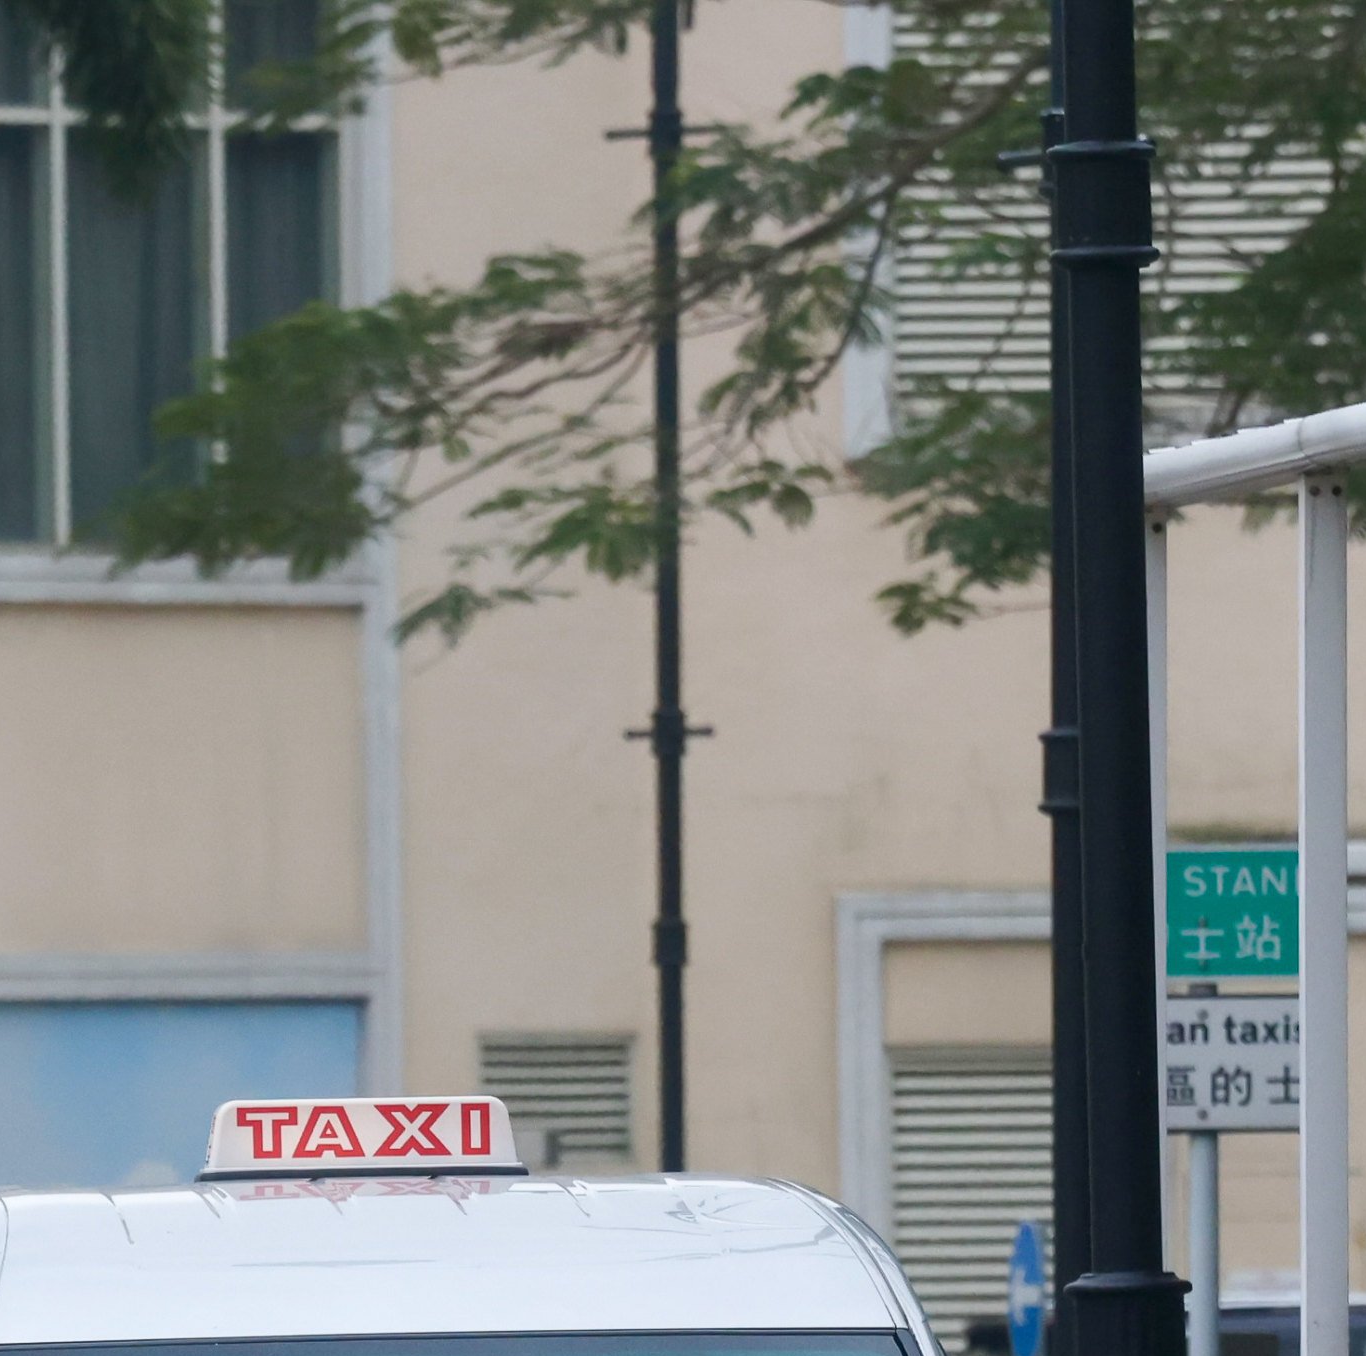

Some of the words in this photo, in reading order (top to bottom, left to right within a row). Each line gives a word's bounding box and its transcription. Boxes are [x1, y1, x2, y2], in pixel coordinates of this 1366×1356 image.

[1184, 865, 1299, 898] STAN
[1166, 914, 1282, 961] 士站
[236, 1102, 491, 1160] TAXI
